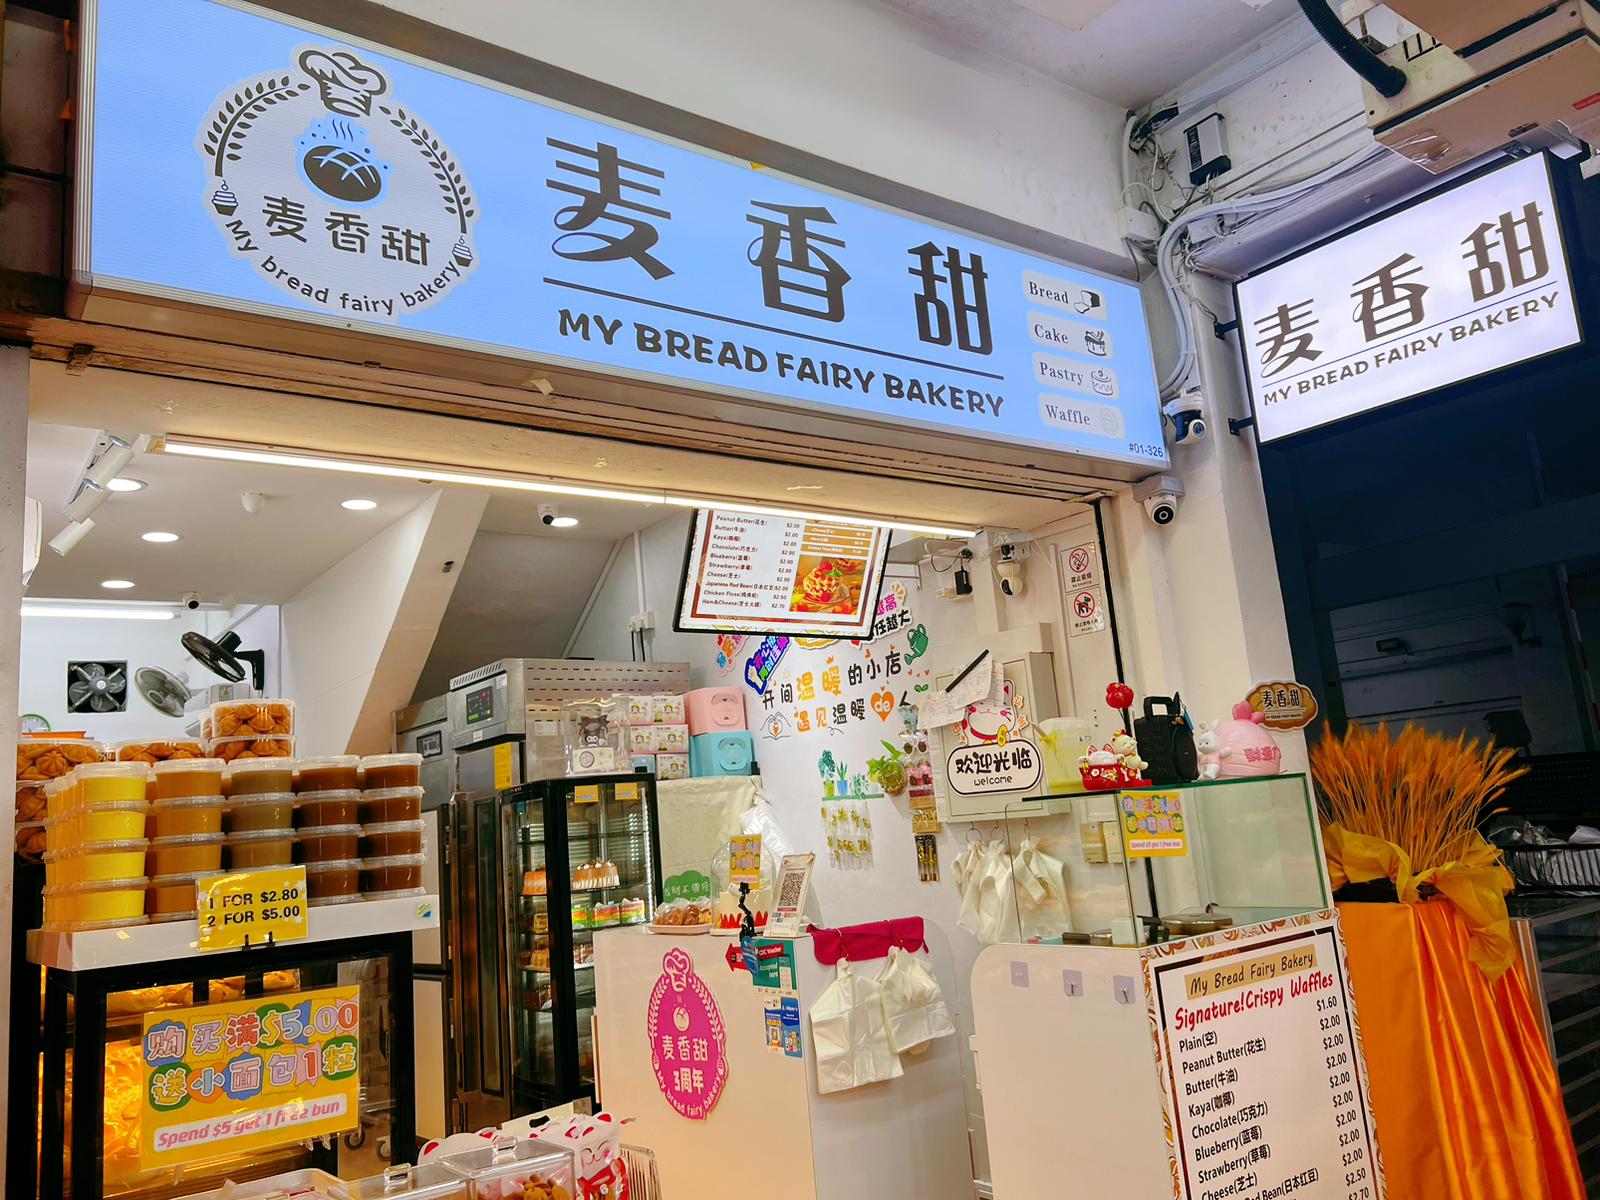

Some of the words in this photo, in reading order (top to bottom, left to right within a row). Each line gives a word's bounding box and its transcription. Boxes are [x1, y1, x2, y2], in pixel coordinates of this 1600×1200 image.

[262, 195, 430, 267] 麦香甜
[545, 137, 993, 355] 麦香甜
[226, 218, 260, 253] My
[260, 255, 329, 304] bread
[340, 292, 394, 316] fairy
[401, 260, 459, 309] bakery
[1254, 201, 1549, 378] 麦香甜
[1028, 281, 1070, 304] Bread
[1034, 324, 1069, 344] Cake
[1263, 386, 1291, 406] MY
[1297, 361, 1369, 395] BREAD
[1374, 333, 1443, 369] FAIRY
[1450, 291, 1558, 342] BAKERY
[558, 308, 623, 344] MY
[635, 322, 768, 373] BREAD
[777, 350, 878, 395] FAIRY
[884, 374, 1005, 418] BAKERY
[1040, 362, 1084, 386] Pastry
[1045, 404, 1091, 426] Waffle
[1129, 442, 1164, 458] #01-326
[1263, 689, 1300, 708] 麦香甜
[955, 748, 1032, 774] 欢迎光临
[974, 775, 1012, 786] welcome
[207, 915, 216, 928] 2
[224, 911, 254, 926] FOR
[262, 906, 300, 920] $5.00
[208, 898, 214, 909] 1
[223, 893, 253, 908] FOR
[260, 888, 299, 903] $2.80
[1191, 978, 1208, 996] My
[1214, 971, 1245, 989] Bread
[1250, 962, 1275, 981] Fairy
[1281, 952, 1314, 970] Bakery
[1290, 970, 1334, 999] Waffles
[148, 1001, 359, 1060] 购买满$5.00
[662, 1034, 708, 1061] 麦香甜
[1179, 1031, 1218, 1054] Plain(空)
[1316, 996, 1337, 1012] $1.60
[1182, 1055, 1215, 1074] Peanut
[1216, 1038, 1267, 1063] Butter(花生)
[1319, 1014, 1341, 1031] $2.00
[151, 1043, 357, 1105] 送小面包1粒
[1185, 1068, 1239, 1096] Butter(牛油)
[1322, 1034, 1344, 1050] $2.00
[1326, 1053, 1347, 1070] $2.00
[158, 1122, 210, 1147] Spend
[213, 1118, 232, 1138] $5
[234, 1115, 261, 1135] get
[266, 1113, 272, 1125] 1
[312, 1100, 340, 1117] bun
[1192, 1101, 1268, 1140] Chocolate(巧克力)
[1329, 1072, 1350, 1089] $2.00
[1195, 1125, 1263, 1162] Blueberry(蓝莓)
[1332, 1091, 1354, 1108] $2.00
[1198, 1144, 1271, 1184] Strawberry(草莓)
[1335, 1110, 1357, 1127] $2.00
[1201, 1172, 1258, 1200] Cheese(芝士)
[1339, 1129, 1360, 1147] $2.00
[1262, 1168, 1319, 1200] Bean(日本红豆)
[1342, 1148, 1363, 1167] $2.00
[1345, 1167, 1367, 1186] $2.50
